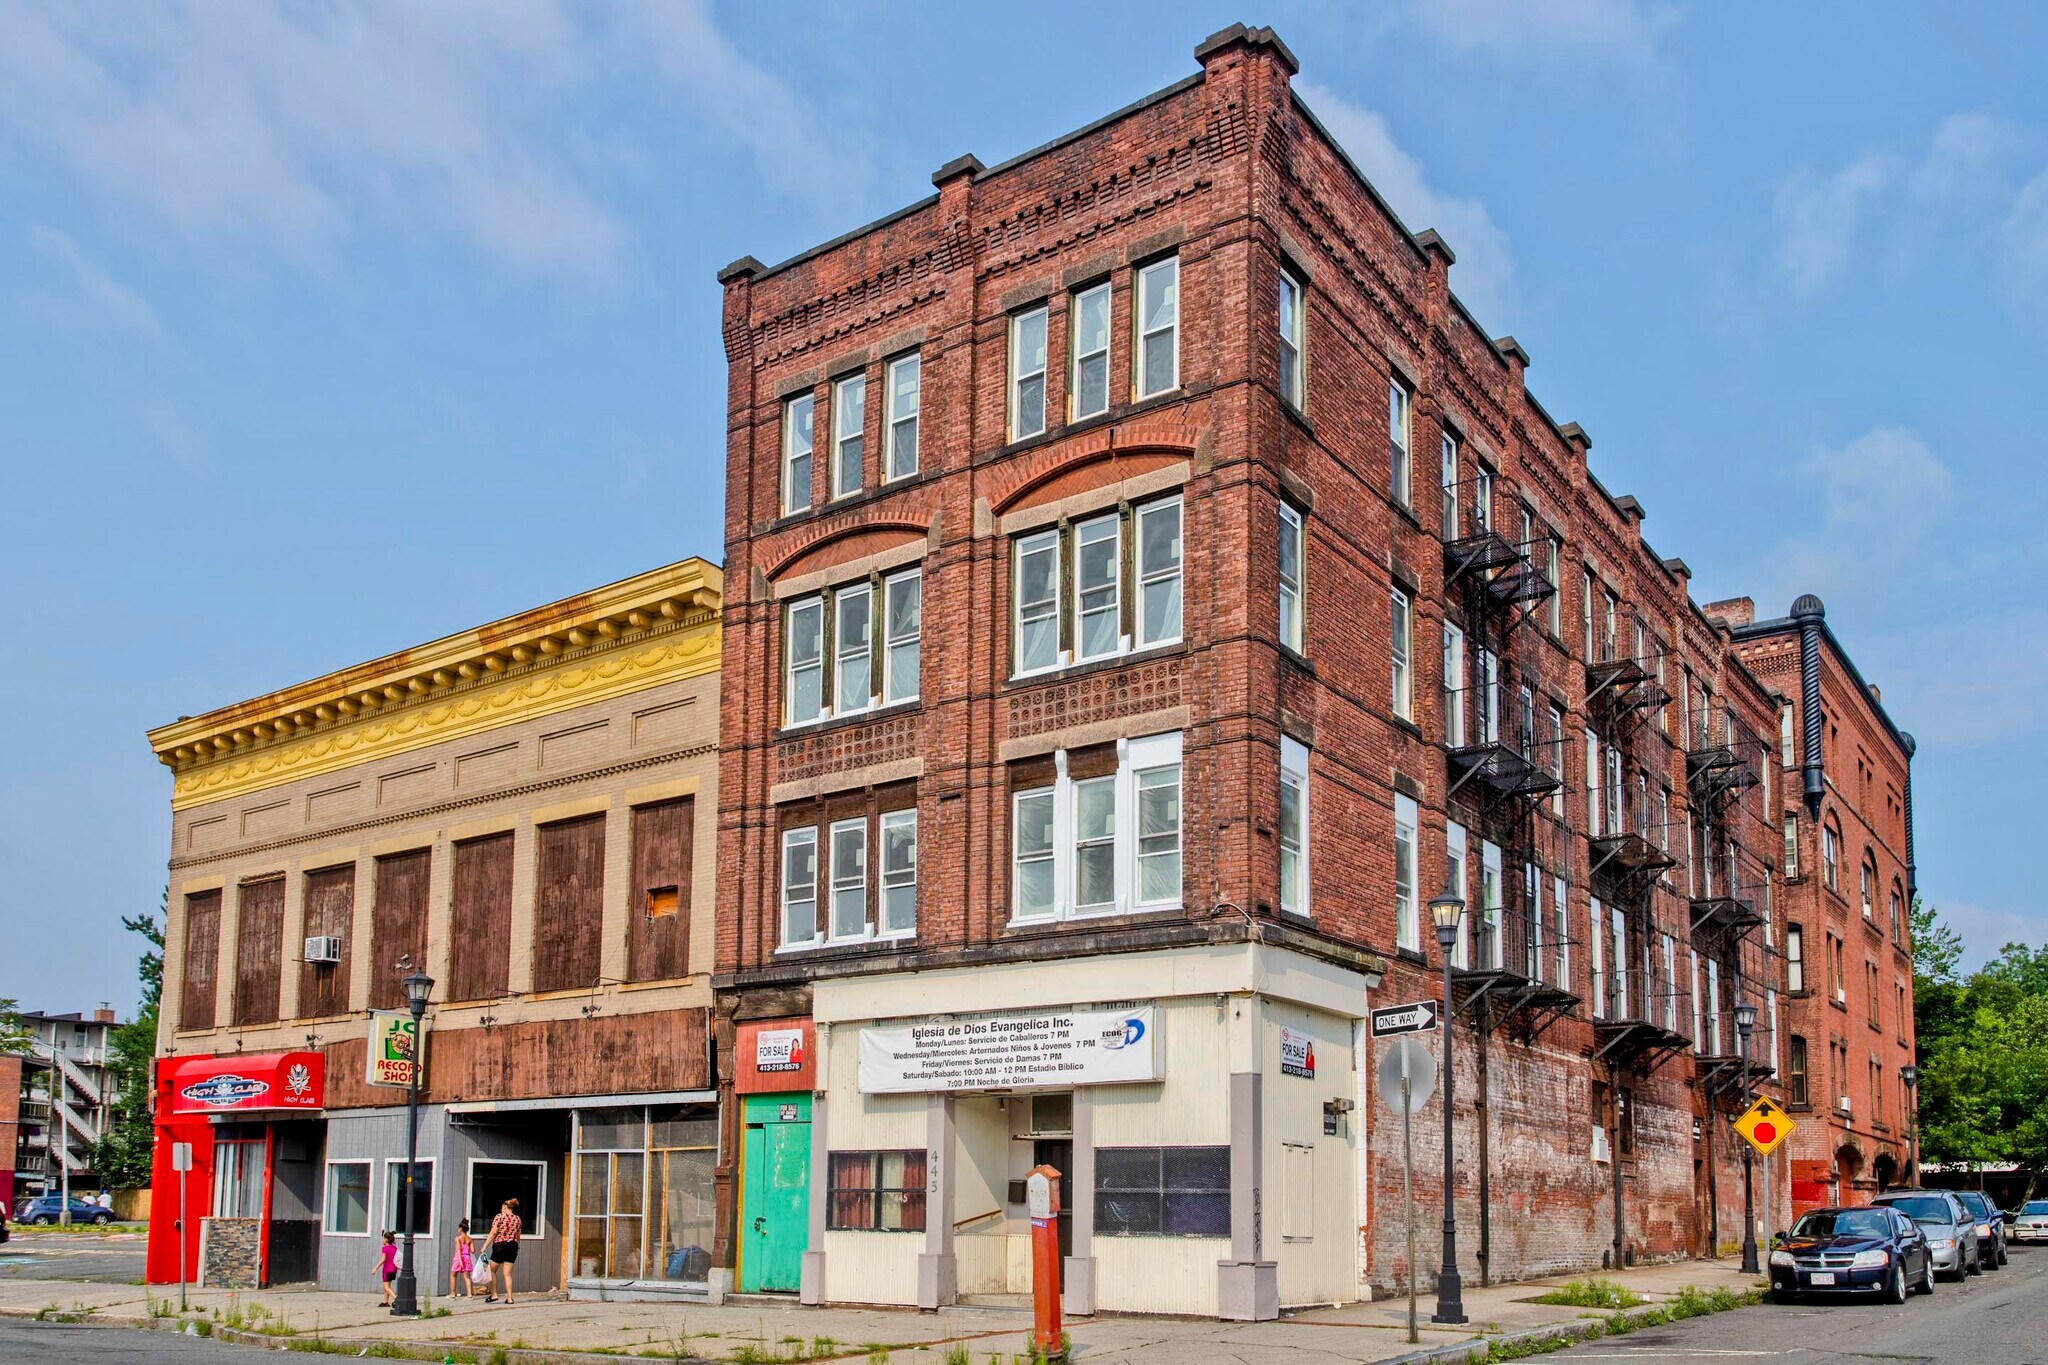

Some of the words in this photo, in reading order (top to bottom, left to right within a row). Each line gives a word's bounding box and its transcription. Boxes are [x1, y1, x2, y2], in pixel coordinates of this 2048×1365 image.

[912, 1027, 945, 1040] Iglesia
[948, 1025, 961, 1036] de
[964, 1023, 987, 1034] Dios
[990, 1019, 1049, 1033] Evangelica
[1053, 1017, 1074, 1028] Inc.
[1379, 1017, 1395, 1028] ONE
[1399, 1013, 1417, 1025] WAY
[916, 1039, 966, 1048] Monday/Lunes:
[968, 1036, 997, 1045] Servicio
[1010, 1032, 1049, 1041] Caballeros
[1058, 1030, 1069, 1038] PM
[760, 1046, 771, 1057] FOR
[773, 1045, 788, 1056] SALE
[893, 1050, 967, 1060] Wednesday/Miercoles:
[1041, 1041, 1072, 1050] Jovenes
[1076, 1040, 1081, 1048] 7
[1083, 1039, 1096, 1047] PM
[1282, 1043, 1292, 1056] FOR
[1293, 1045, 1305, 1059] SALE
[922, 1060, 972, 1069] Friday/Viernes:
[974, 1056, 1003, 1065] Servicio
[1005, 1055, 1014, 1063] de
[1016, 1054, 1041, 1062] Damas
[1050, 1053, 1062, 1061] PM
[903, 1070, 961, 1080] Saturday/Sabado:
[964, 1068, 983, 1076] 10:00
[985, 1067, 997, 1075] AM
[1004, 1066, 1012, 1074] 12
[1014, 1065, 1027, 1073] PM
[1058, 1062, 1084, 1070] Biblico
[964, 1078, 975, 1086] PM
[977, 1077, 1000, 1086] Noche
[1012, 1076, 1034, 1084] Gloria
[186, 1087, 214, 1097] HIGH
